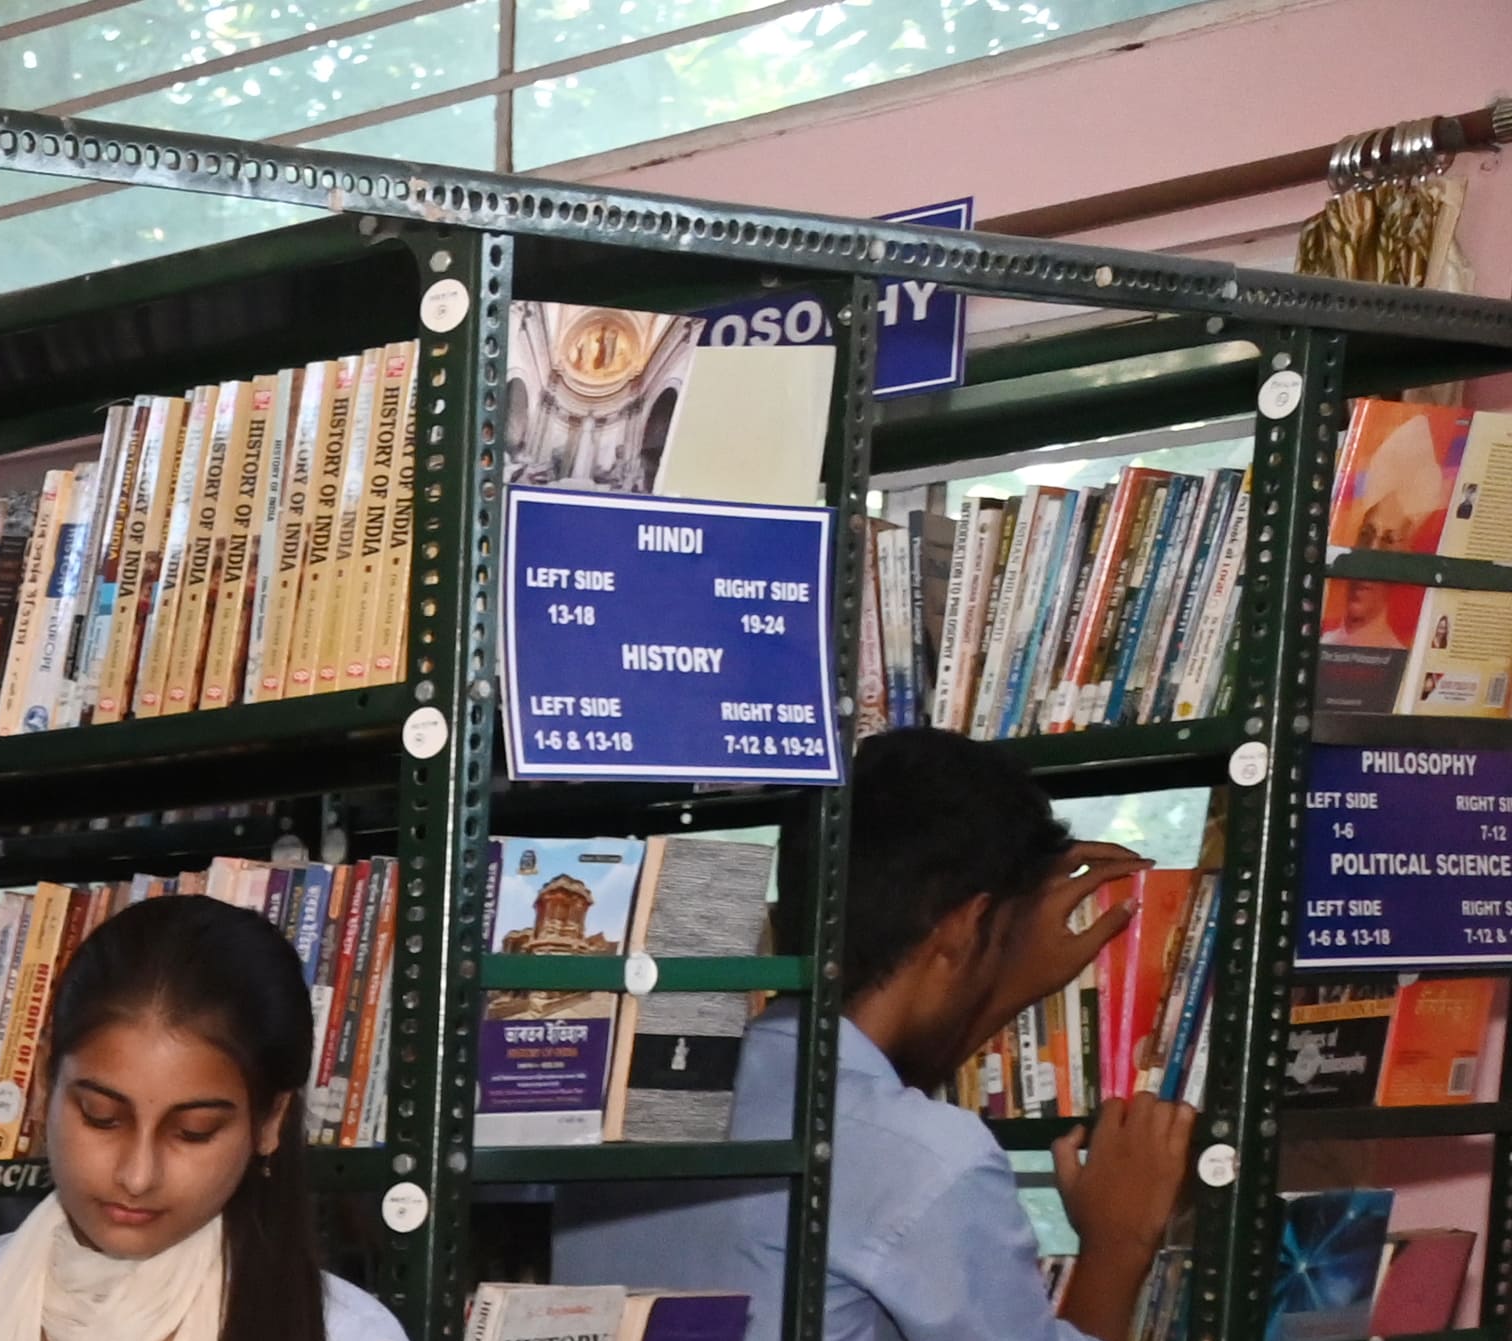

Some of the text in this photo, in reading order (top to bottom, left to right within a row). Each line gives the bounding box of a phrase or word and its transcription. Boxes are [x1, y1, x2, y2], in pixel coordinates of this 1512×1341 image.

[224, 418, 266, 584] HISTORY OF INDIA
[639, 525, 702, 553] HINDI
[527, 567, 809, 602] LEFT SIDE RIGHT SIDE
[548, 605, 785, 634] 13-18 19-24
[622, 644, 723, 673] HISTORY
[531, 696, 816, 723] LEFT SIDE RIGHT SIDE
[535, 730, 824, 756] 1-6 & 13-18 7-12 & 19-24
[1362, 751, 1476, 775] PHILOSOPHY
[1307, 792, 1495, 811] LEFT SIDE RIGHT
[1333, 823, 1506, 841] 1-6 7-12
[1331, 853, 1512, 876] POLITICAL SCIENCE
[1308, 900, 1501, 916] LEFT SIDE RIGHT
[1308, 928, 1493, 946] 1-6 & 13-18 7-12
